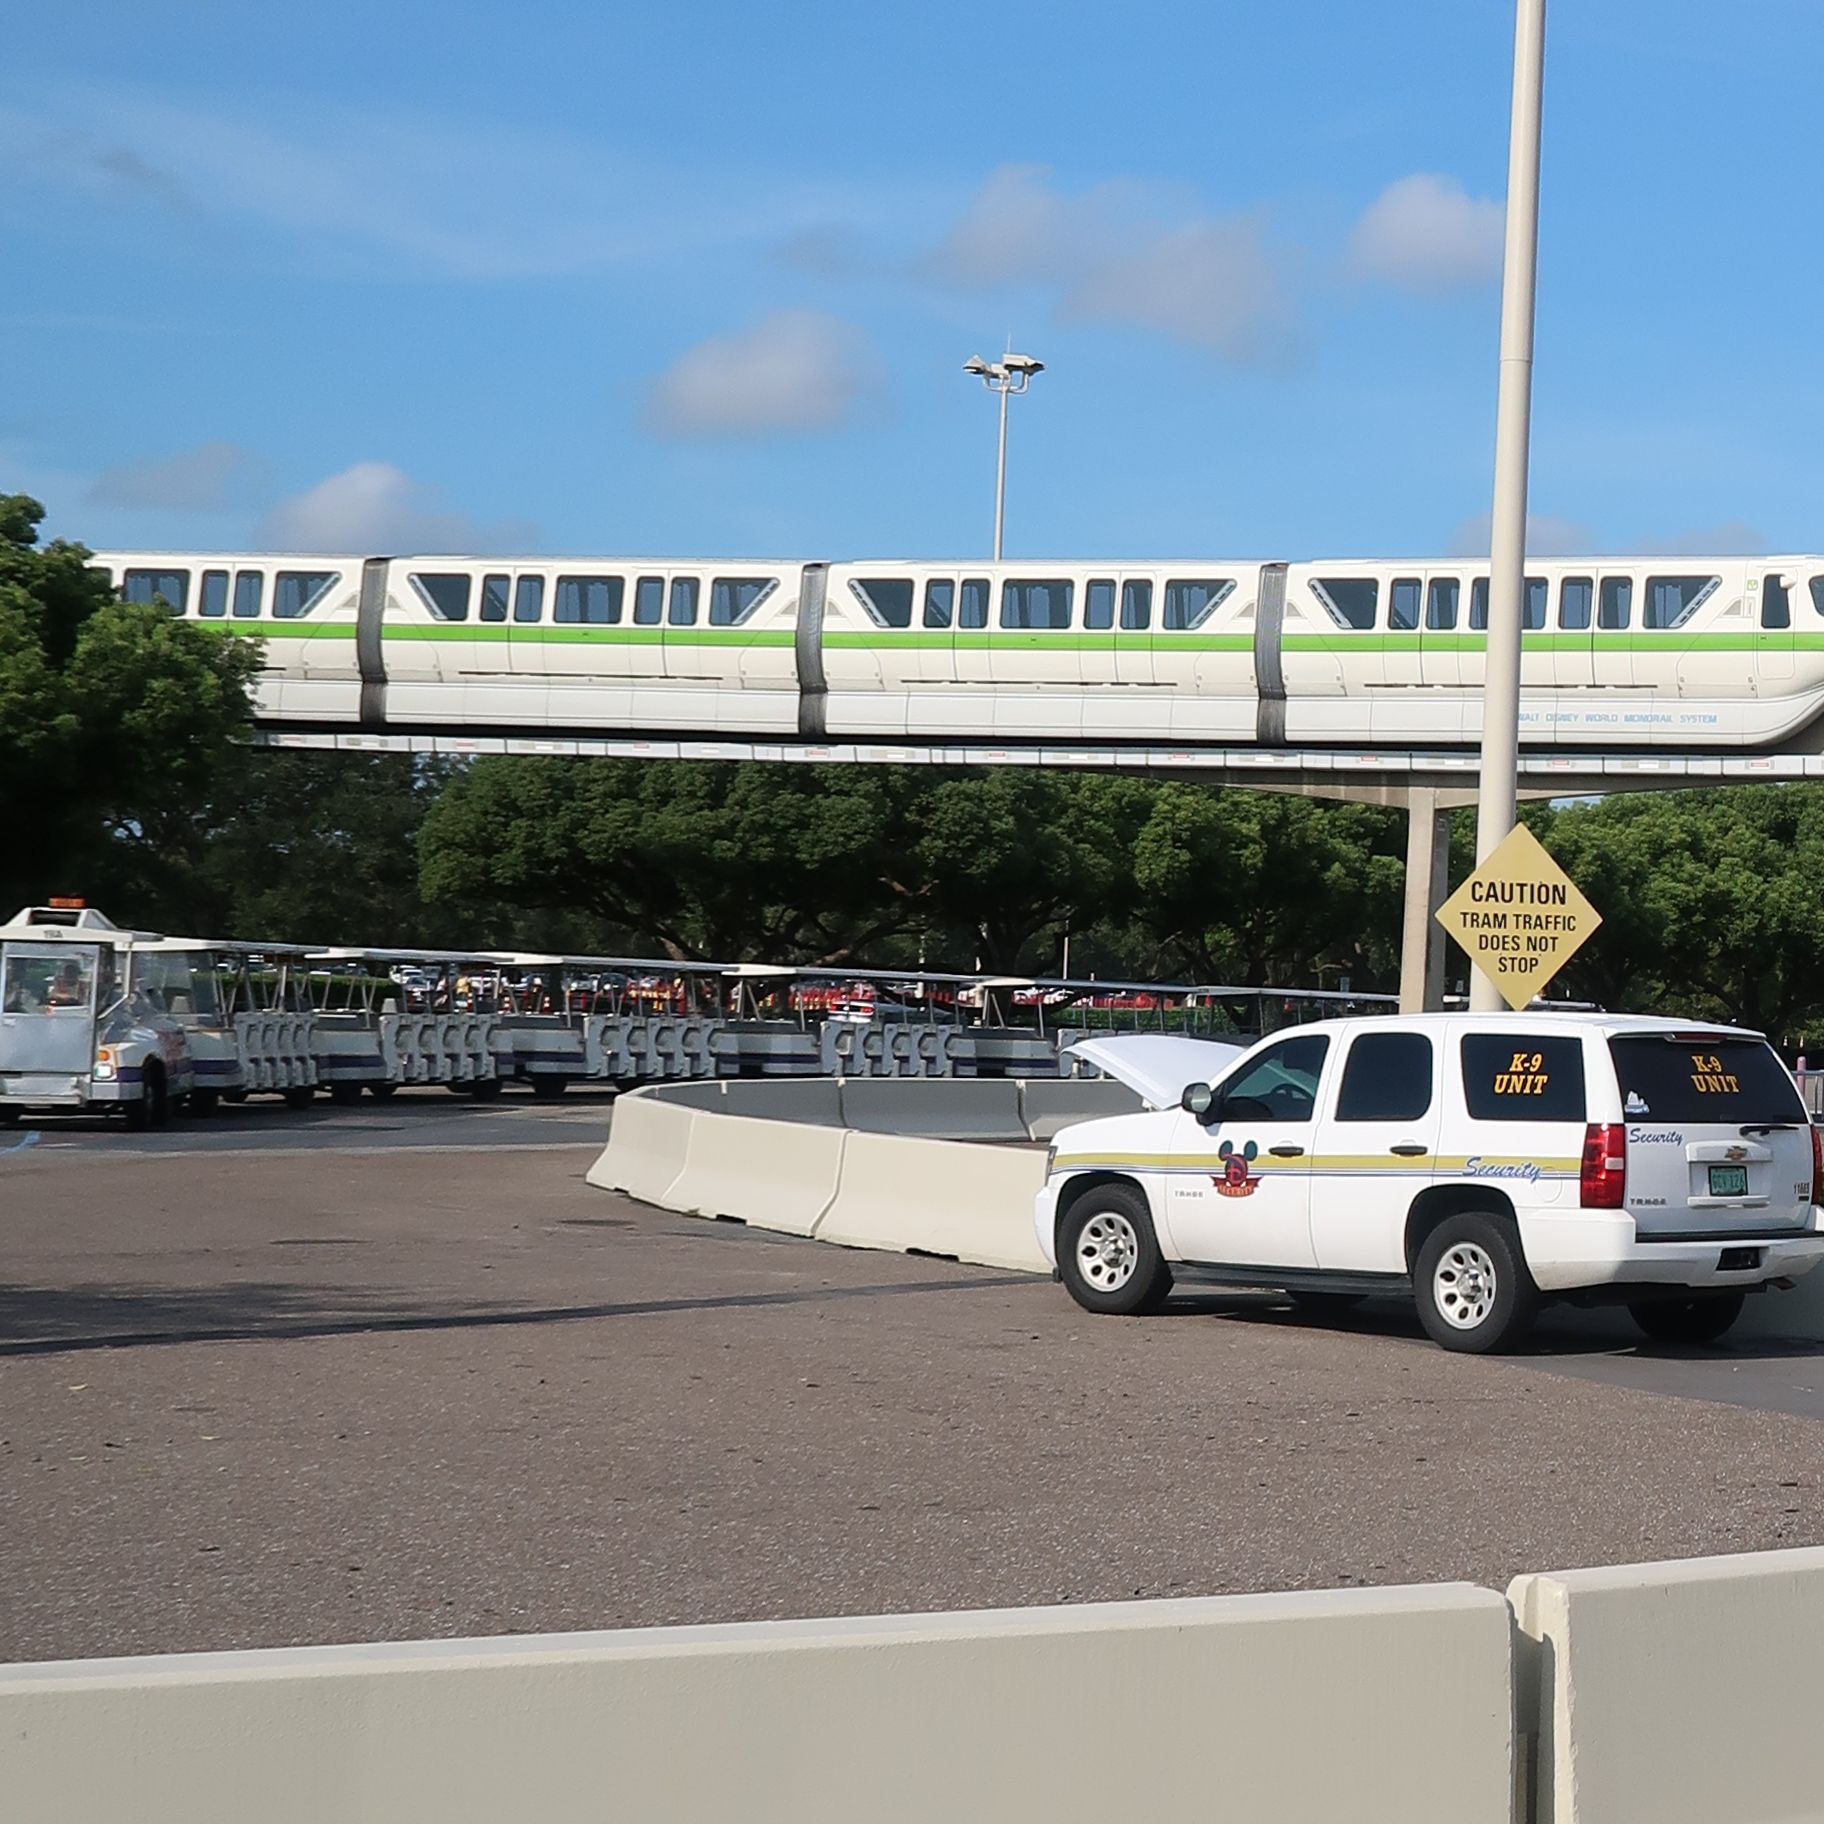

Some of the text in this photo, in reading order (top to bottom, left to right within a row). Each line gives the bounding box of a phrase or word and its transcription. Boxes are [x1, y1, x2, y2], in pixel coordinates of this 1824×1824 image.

[1518, 713, 1717, 724] WALT DISNEY WORLD MONORAIL SYSTEM
[1471, 881, 1566, 905] CAUTION
[1460, 912, 1577, 932] TRAM TRAFFIC
[1478, 934, 1559, 952] DOES NOT
[1498, 956, 1539, 973] STOP
[1509, 1053, 1543, 1073] K-9
[1691, 1055, 1723, 1073] K-9
[1494, 1074, 1549, 1094] UNIT
[1691, 1074, 1740, 1093] UNIT
[1628, 1127, 1683, 1146] Security
[1461, 1156, 1541, 1185] Security
